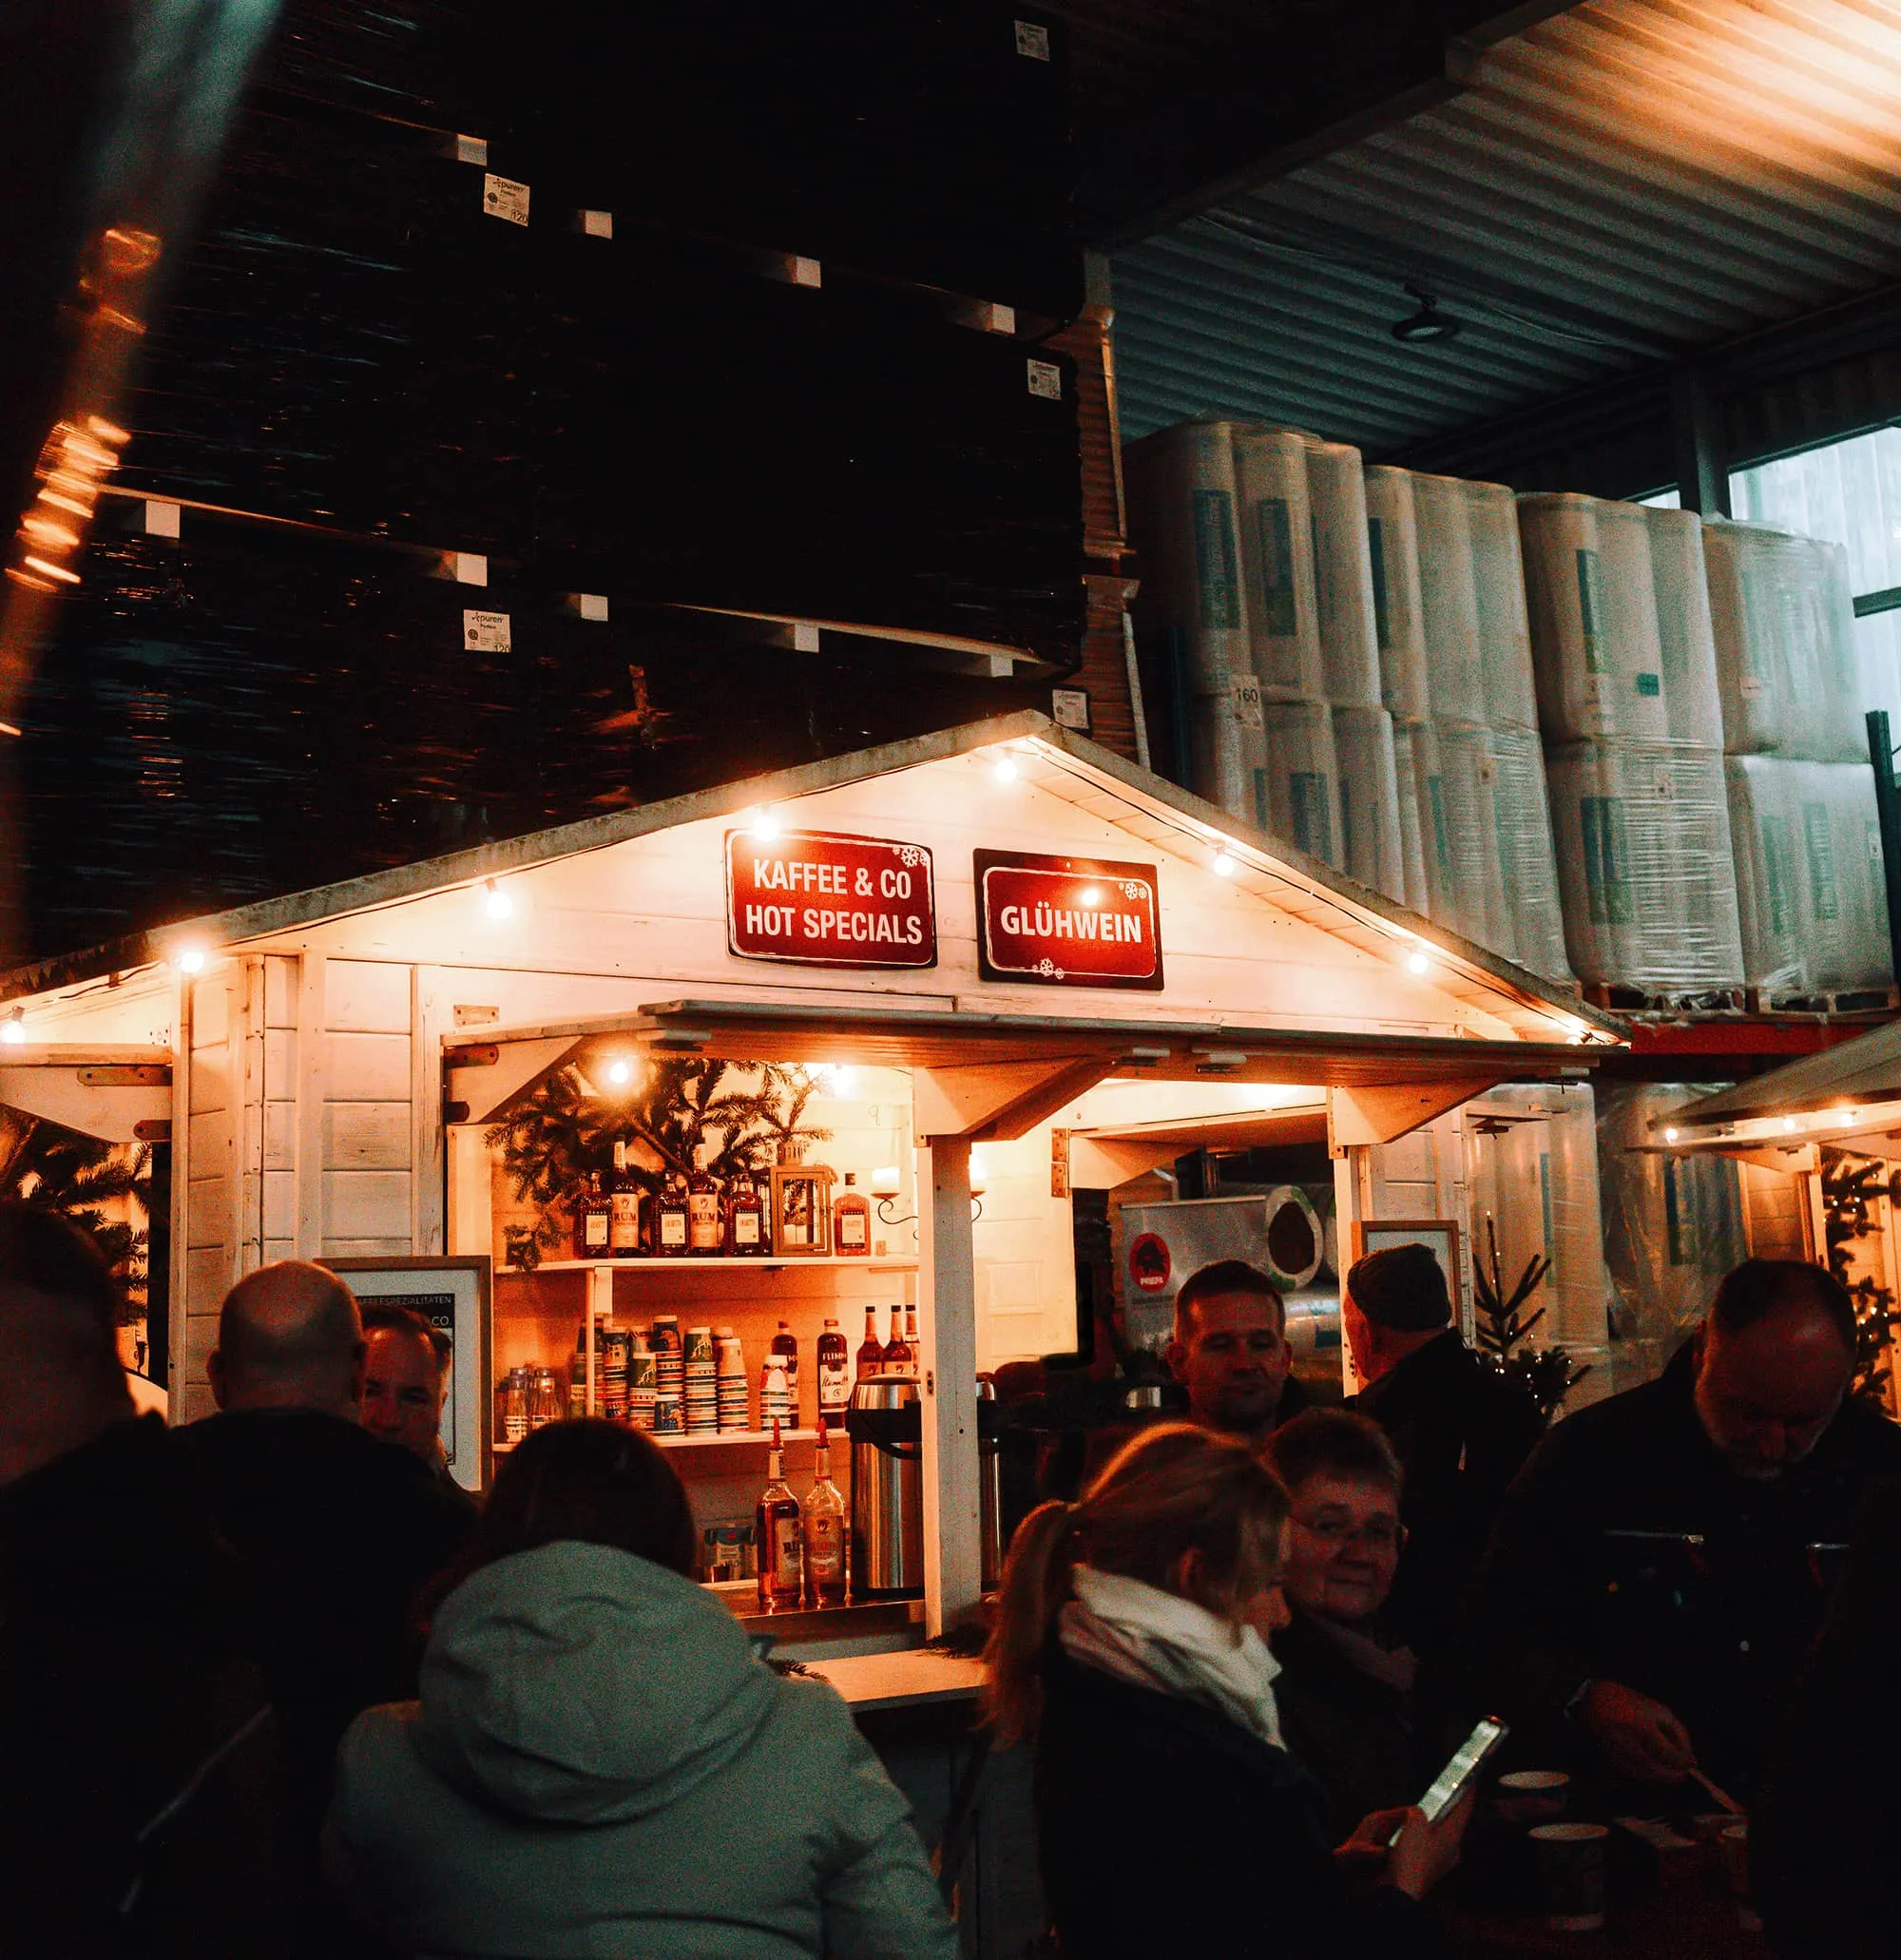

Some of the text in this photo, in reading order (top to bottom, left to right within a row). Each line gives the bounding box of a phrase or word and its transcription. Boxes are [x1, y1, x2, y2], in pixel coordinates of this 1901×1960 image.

[1237, 688, 1258, 702] 160
[753, 859, 912, 899] KAFFEE & CO
[746, 905, 923, 945] HOT SPECIALS
[1001, 901, 1143, 943] GLÜHWEIN
[613, 1212, 637, 1221] RUM
[692, 1212, 715, 1221] RUM
